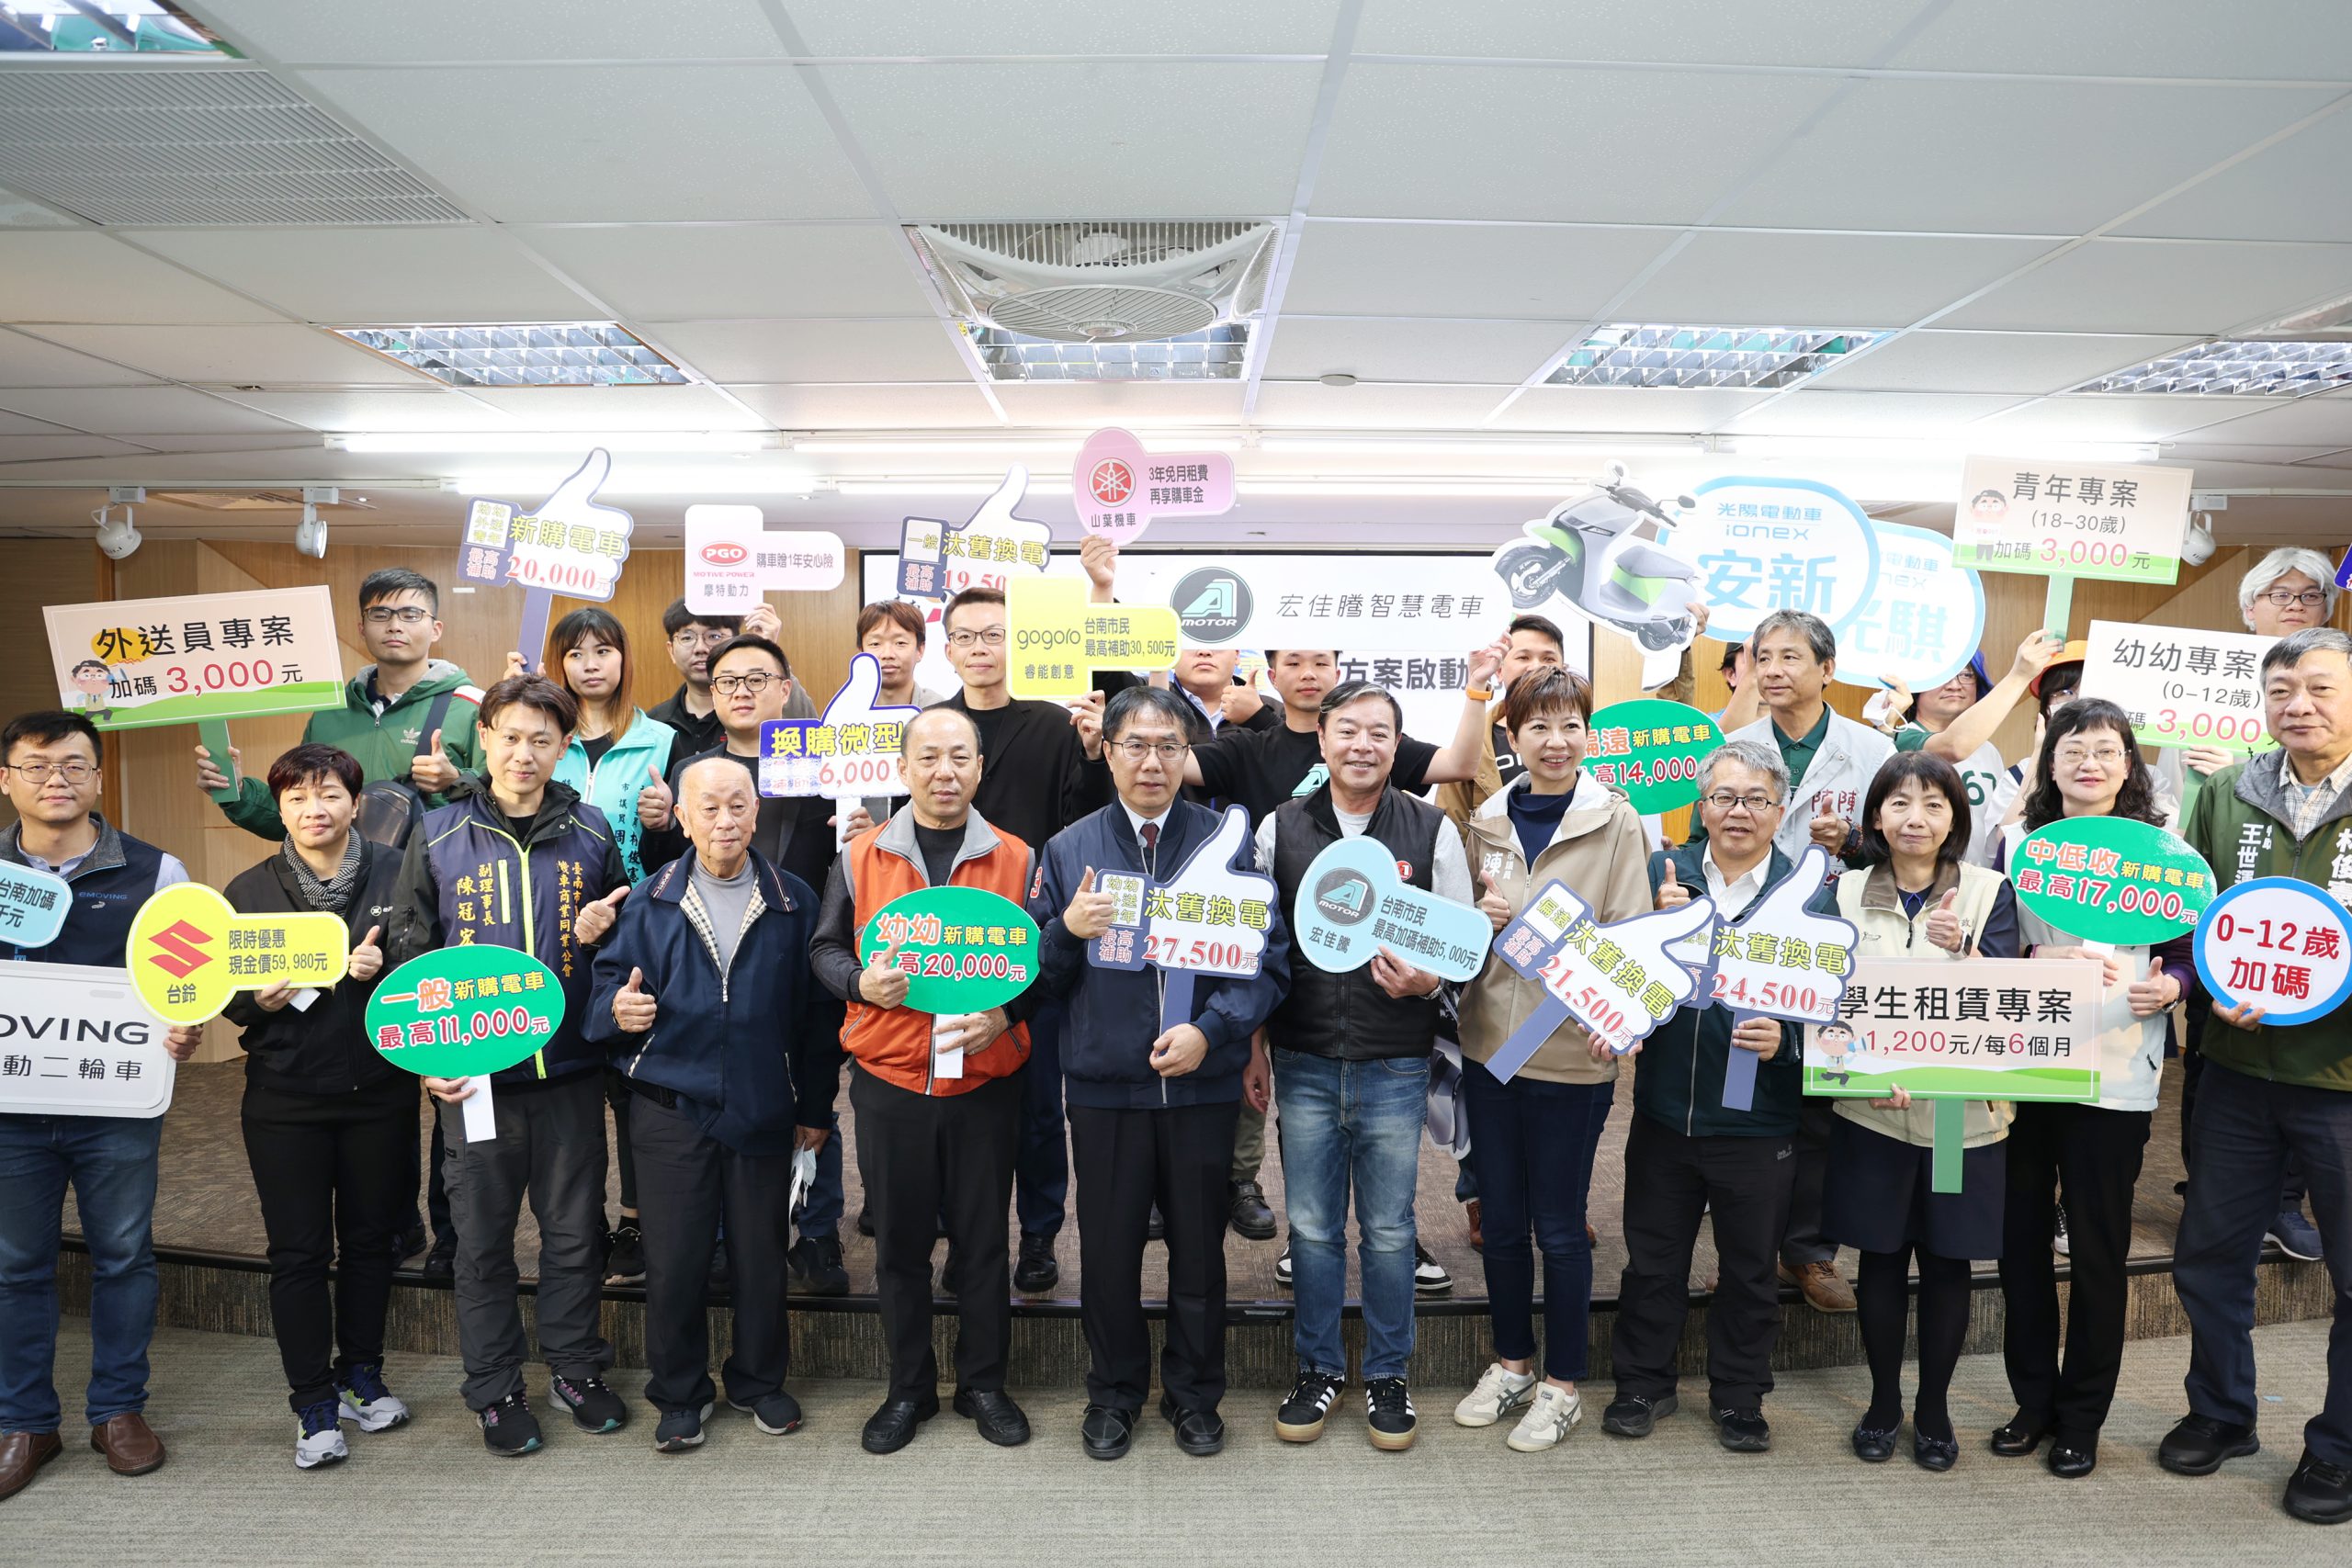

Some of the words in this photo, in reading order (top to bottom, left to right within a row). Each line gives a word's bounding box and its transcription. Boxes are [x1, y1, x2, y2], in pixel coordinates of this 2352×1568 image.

[1148, 464, 1208, 483] 3年免月租費
[1149, 486, 1204, 505] 再享購車金
[2013, 471, 2139, 508] 青年專案
[1091, 513, 1136, 528] 山葉機車
[1717, 502, 1823, 522] 光陽電動車
[509, 515, 625, 558] 新購電車
[907, 533, 939, 549] 一般
[1725, 524, 1810, 541] ionex
[469, 547, 500, 567] 最高
[706, 547, 743, 559] PGO
[756, 553, 833, 569] 購車贈1年安心險
[942, 532, 1045, 566] 汰舊換電
[1995, 540, 2032, 560] 加碼
[2040, 537, 2128, 568] 3,000
[2132, 551, 2151, 570] 元
[505, 556, 612, 592] 20,000元
[904, 577, 933, 592] 補助
[906, 563, 934, 579] 最高
[1698, 548, 1838, 615] 安新
[704, 583, 749, 597] 摩特動力
[1276, 592, 1485, 619] 宏佳騰智慧電車
[96, 615, 294, 660] 外送員專案
[1017, 628, 1081, 649] gogoro
[1084, 616, 1130, 635] 台南市民
[1024, 664, 1075, 680] 睿能創意
[2113, 637, 2256, 680] 幼幼專案
[108, 675, 157, 700] 加碼
[165, 659, 275, 697] 3,000
[281, 663, 303, 683] 元
[2156, 708, 2261, 743] 3,000
[478, 863, 496, 926] 副理事長
[1106, 875, 1139, 892] 幼幼
[1144, 889, 1268, 929] 汰舊換電
[1380, 895, 1428, 927] 台南市民
[1536, 897, 1573, 931] 偏遠
[229, 929, 286, 950] 限時優惠
[1101, 929, 1135, 947] 最高
[1308, 926, 1351, 953] 宏佳騰
[1512, 926, 1545, 956] 最高
[2216, 913, 2340, 960] 0-12歲
[1099, 945, 1132, 964] 補助
[1142, 934, 1259, 970] 27,500元
[1502, 938, 1532, 967] 補助
[1713, 927, 1848, 975] 汰舊換電
[1564, 919, 1676, 1019] 汰舊換電
[2227, 956, 2312, 1000] 加碼
[166, 983, 197, 1004] 台鈴
[1536, 954, 1635, 1047] 21,500元
[1709, 973, 1836, 1016] 24,500元
[1838, 986, 2073, 1023] 學生租賃專案
[1866, 1030, 2072, 1056] 1,200元/每6個月
[3, 1055, 142, 1081] 動二輪車
